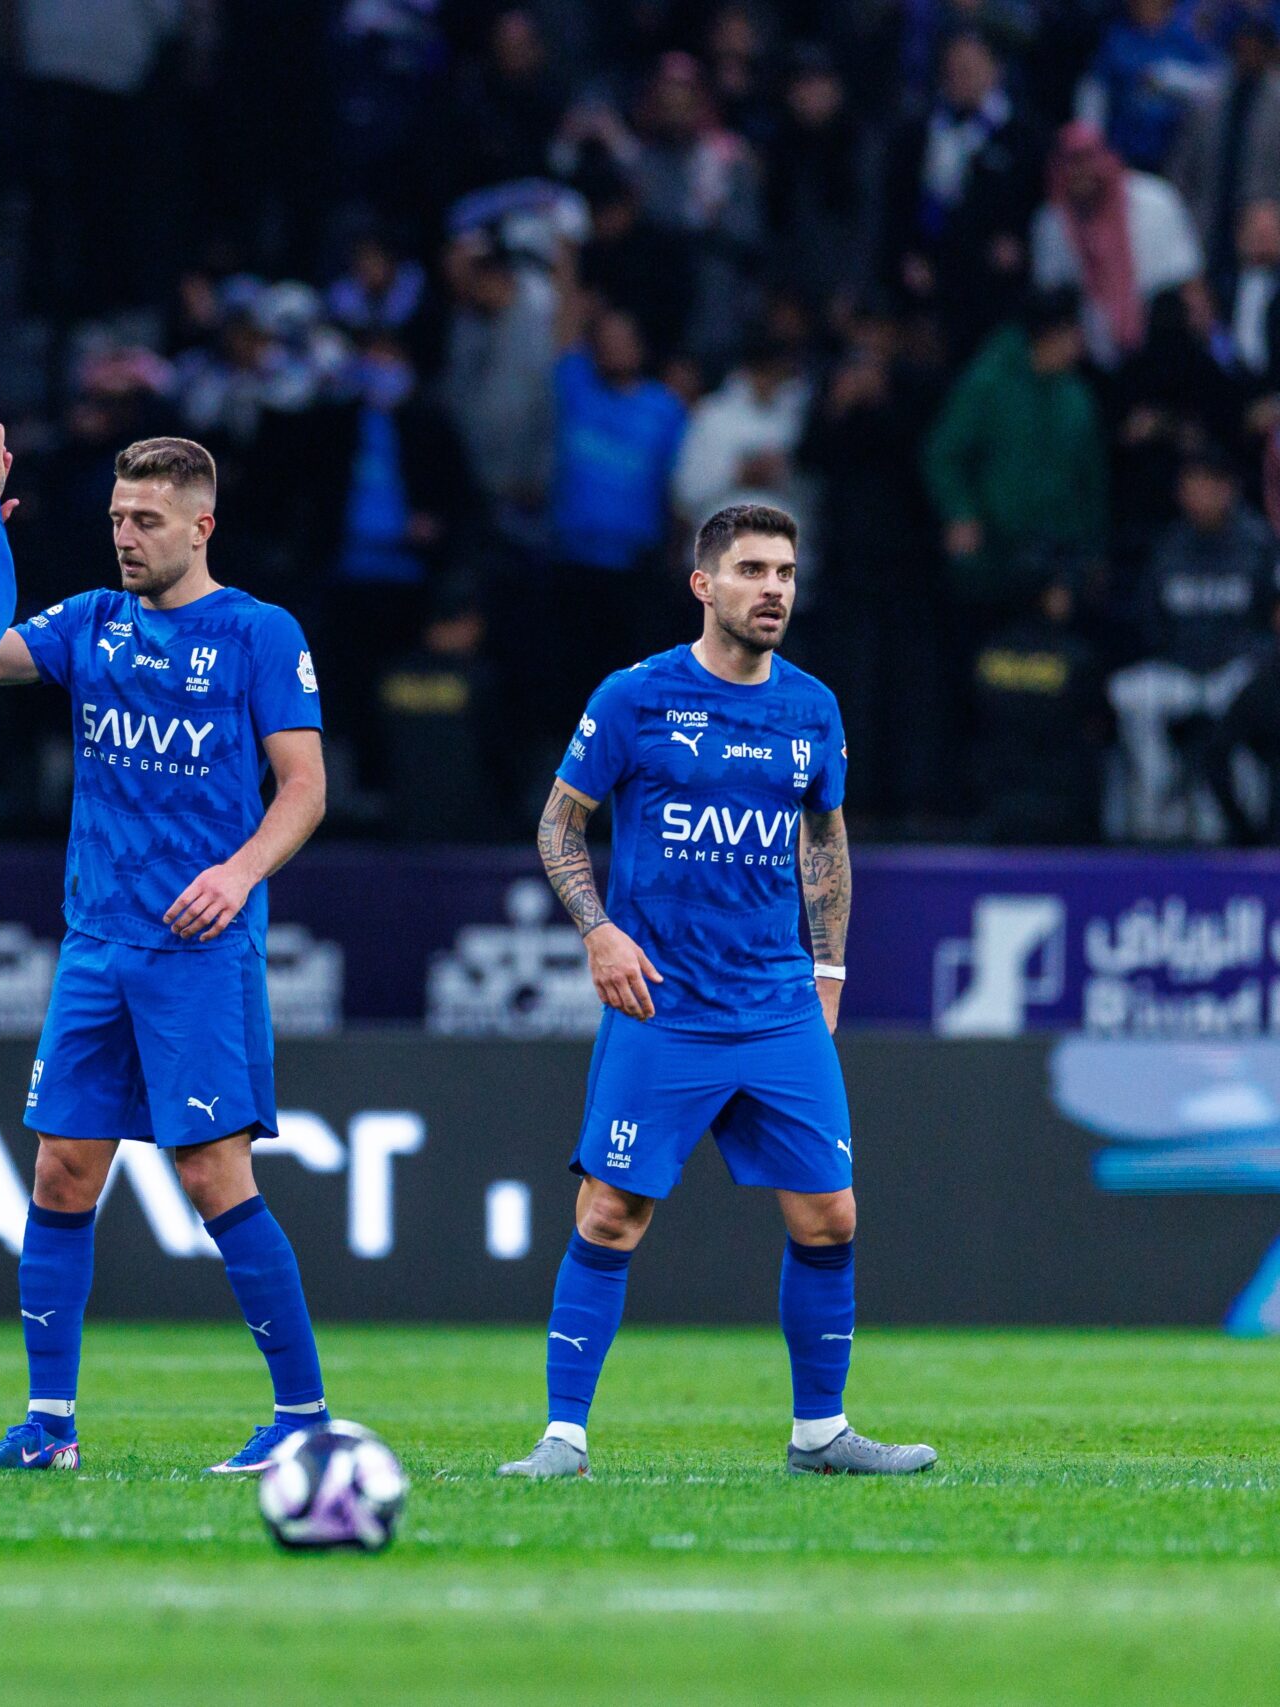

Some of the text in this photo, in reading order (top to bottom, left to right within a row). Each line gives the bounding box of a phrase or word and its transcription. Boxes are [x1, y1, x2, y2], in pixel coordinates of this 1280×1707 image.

[666, 710, 708, 724] flynas
[82, 703, 214, 757] SAVVY
[140, 759, 210, 776] GROUP
[662, 802, 798, 848] SAVVY
[664, 847, 734, 863] GAMES
